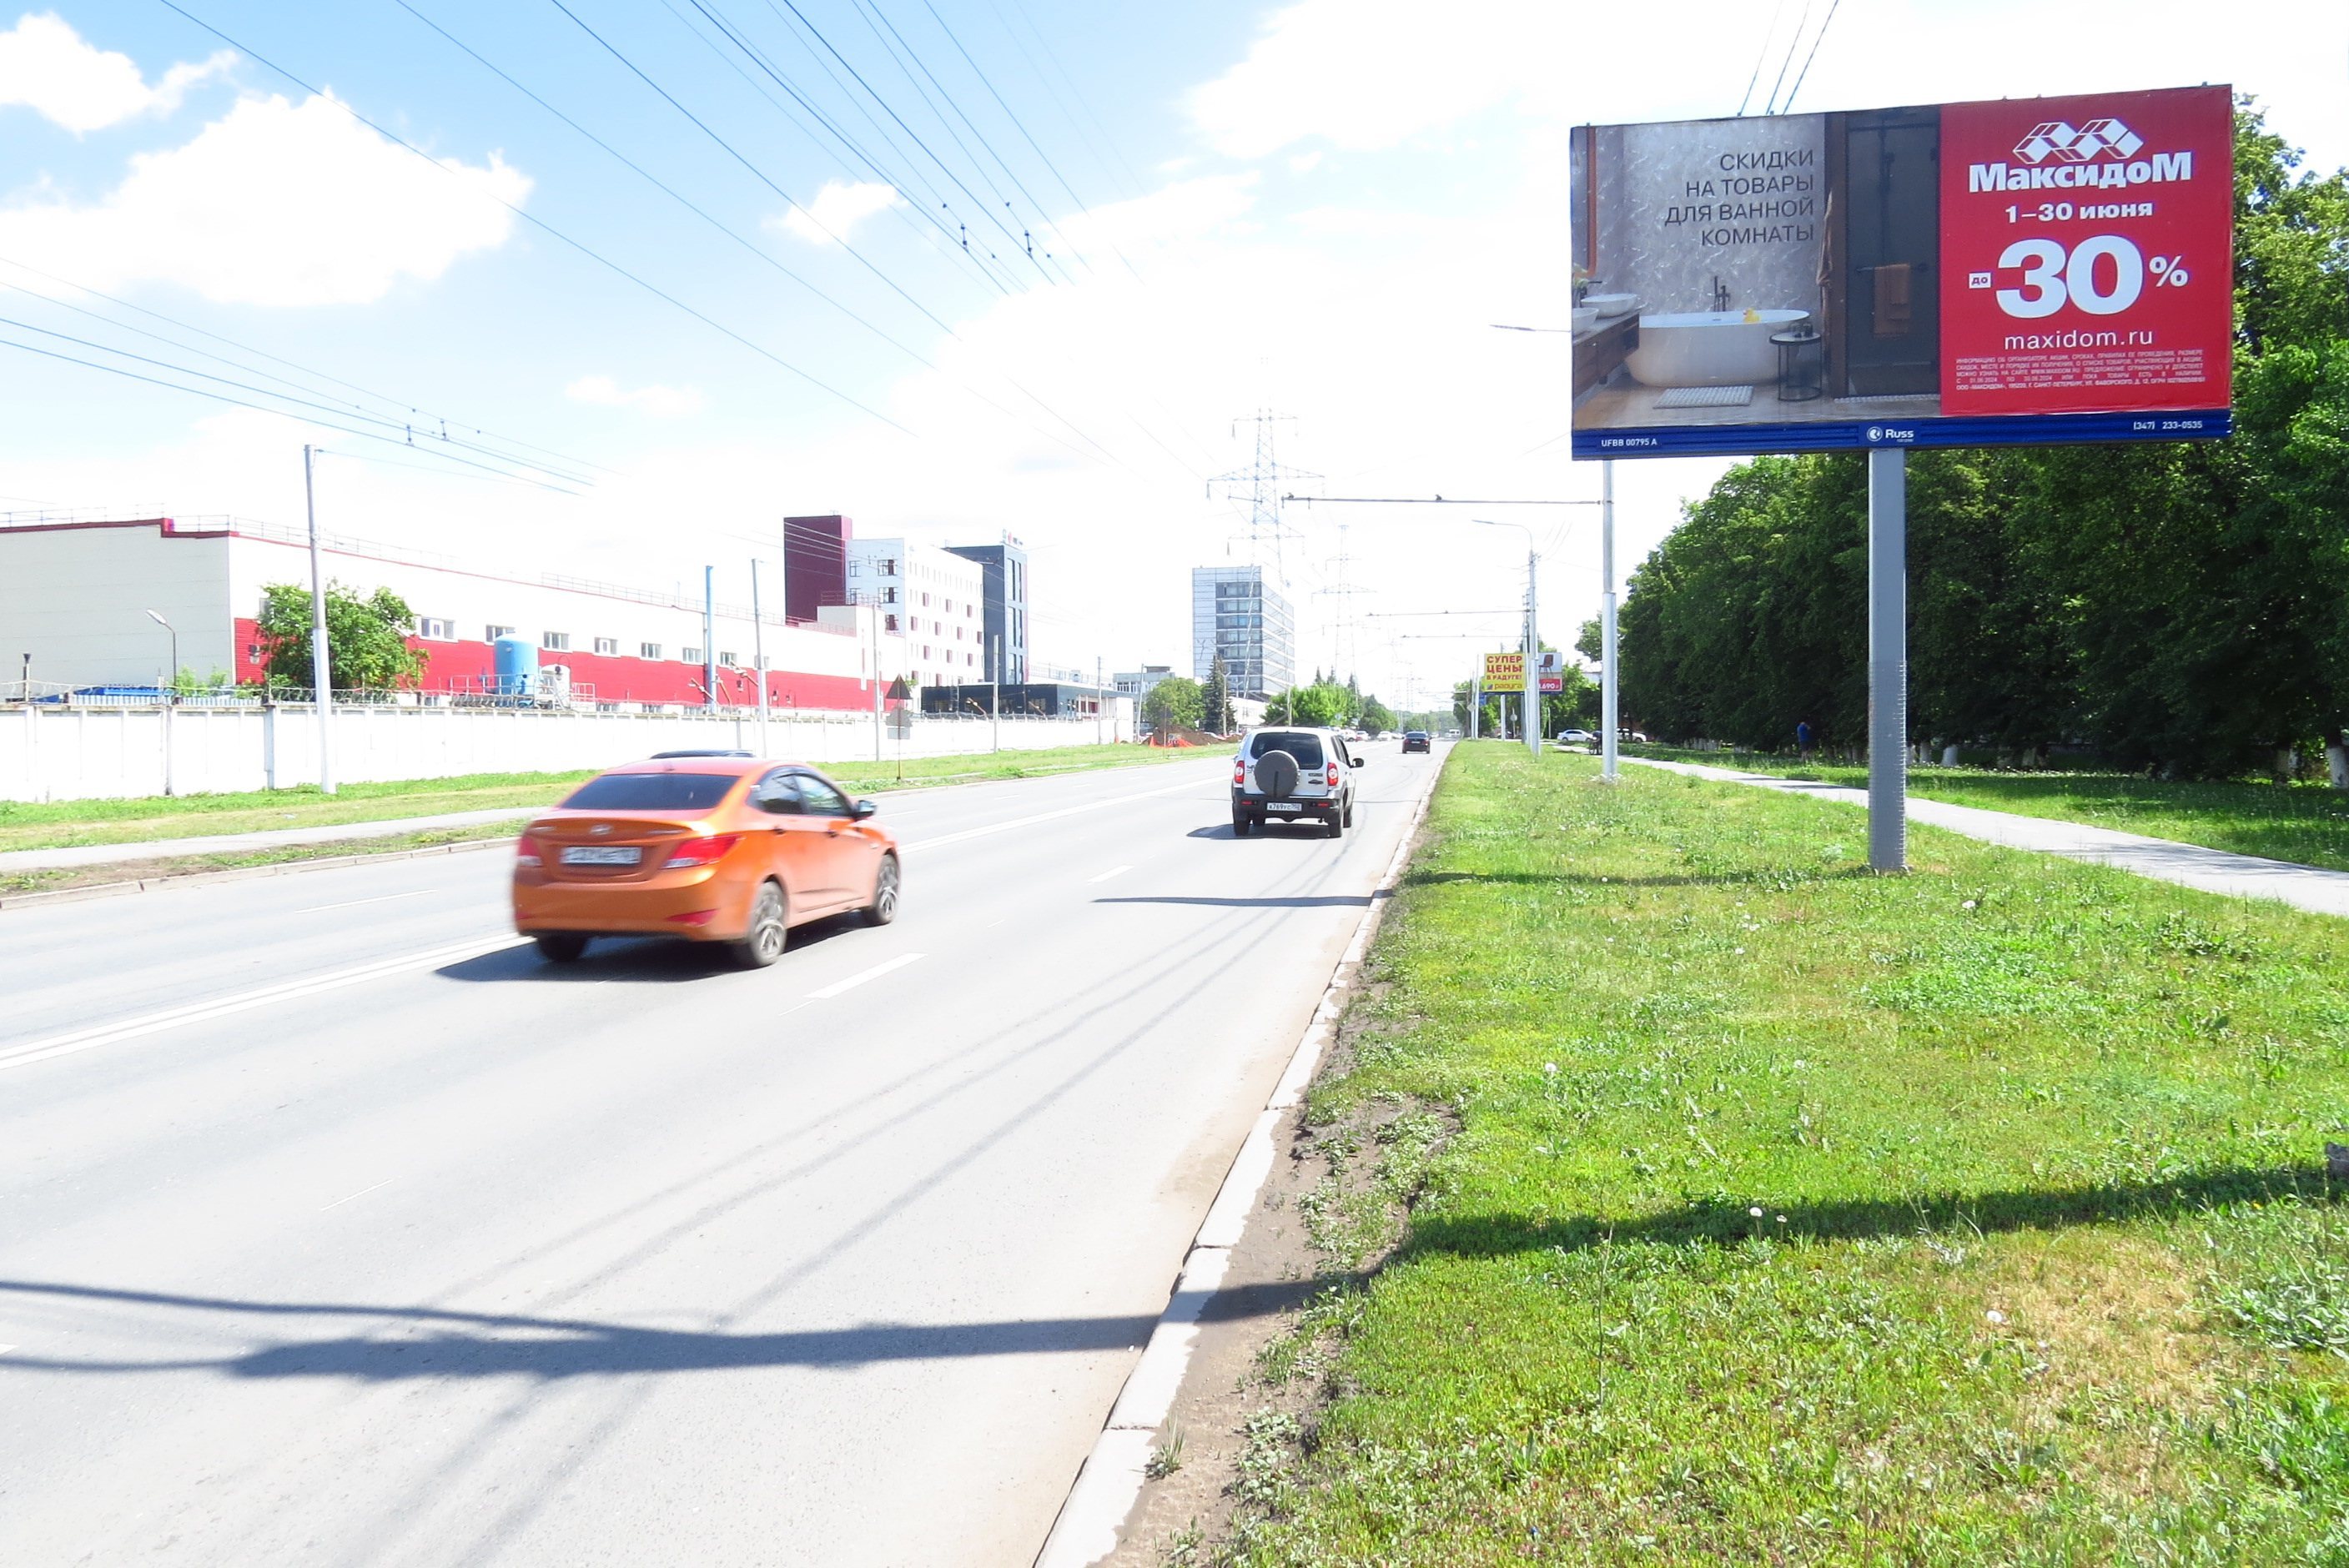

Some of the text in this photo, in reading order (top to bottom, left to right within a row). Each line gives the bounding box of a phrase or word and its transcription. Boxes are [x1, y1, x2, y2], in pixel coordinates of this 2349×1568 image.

[1720, 149, 1813, 171] СКИДКИ
[1969, 151, 2192, 193] МаксидоМ
[1686, 174, 1813, 198] НА ТОВАРЫ
[1664, 196, 1813, 227] ДЛЯ ВАННОЙ
[2080, 203, 2154, 220] июня
[1702, 224, 1813, 247] КОМНАТЫ
[1971, 275, 1989, 286] до
[2004, 330, 2153, 350] maxidom.ru
[1885, 429, 1914, 438] Russ
[2162, 420, 2203, 430] 233-0535
[1601, 439, 1624, 447] UFBB
[1626, 438, 1650, 446] 00795
[1486, 665, 1522, 673] ЦЕНЫ
